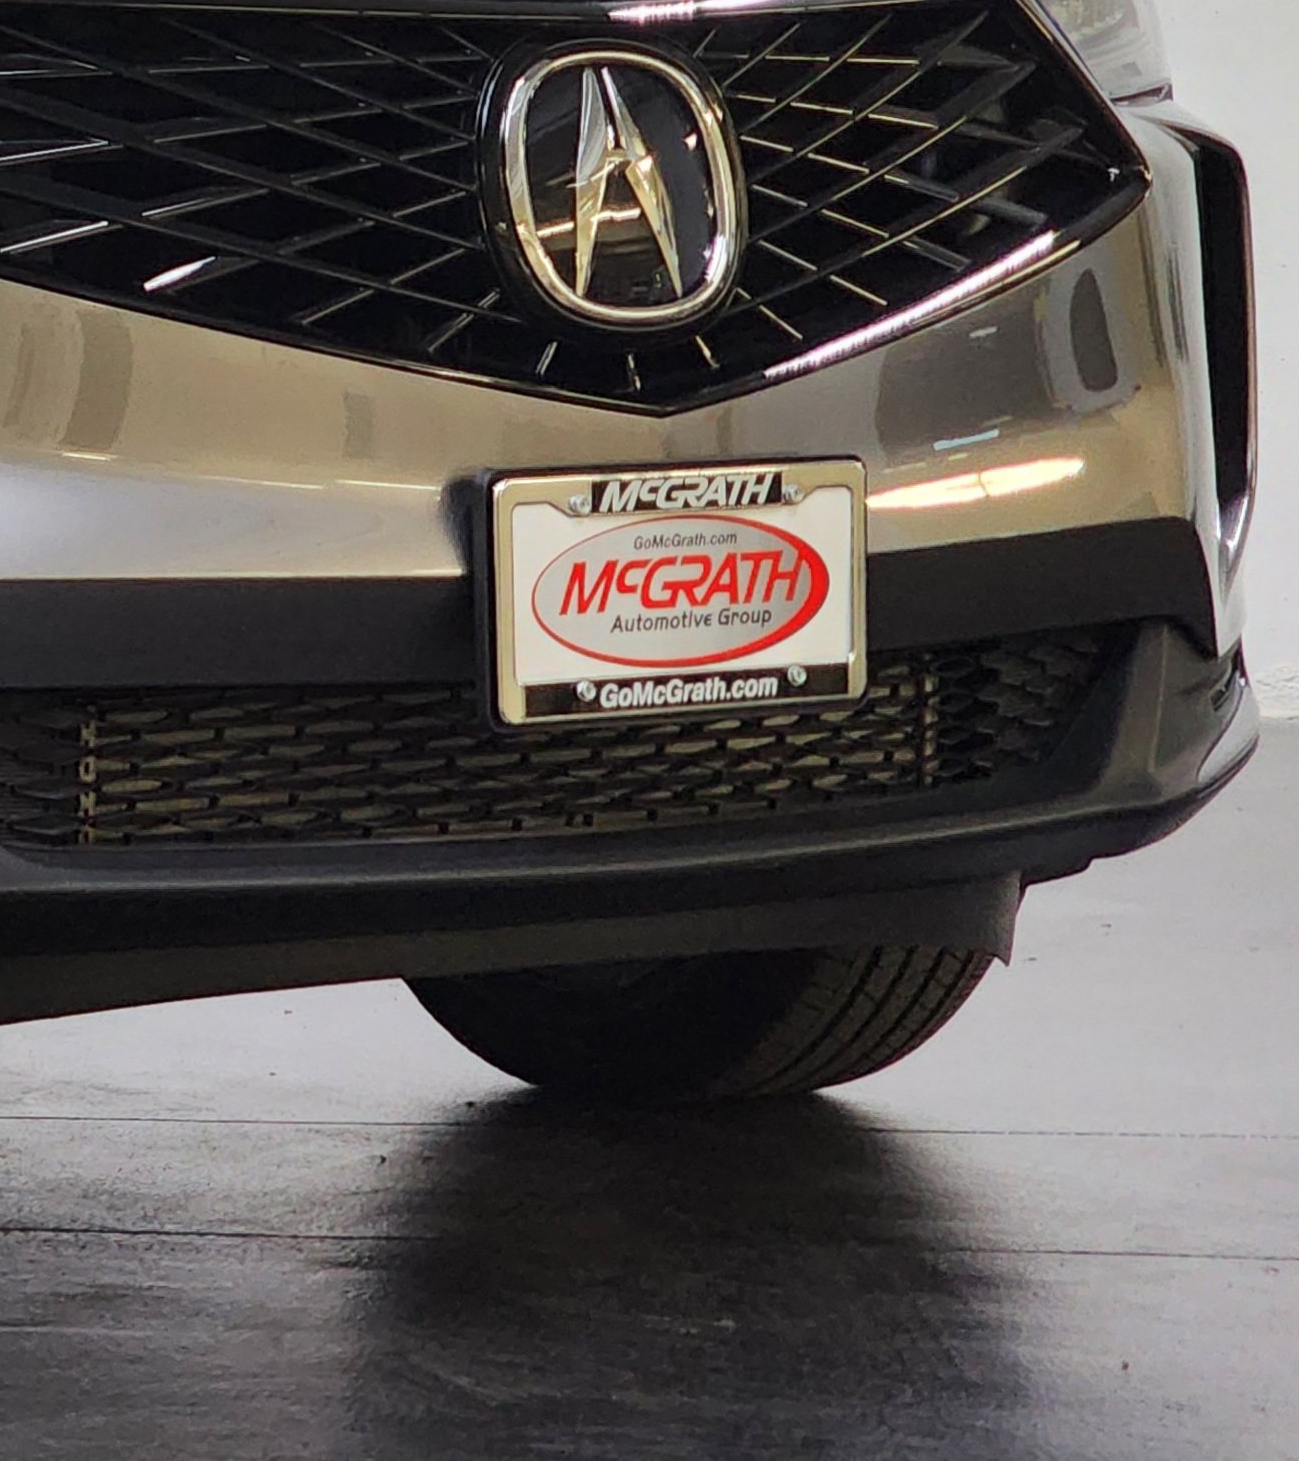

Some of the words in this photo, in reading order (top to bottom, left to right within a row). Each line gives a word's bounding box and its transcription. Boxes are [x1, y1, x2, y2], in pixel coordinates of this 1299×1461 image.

[633, 533, 737, 550] GoMcGrath.com
[610, 612, 713, 634] Automotive
[717, 608, 772, 629] Group
[600, 675, 779, 709] GoMcGrath.com
